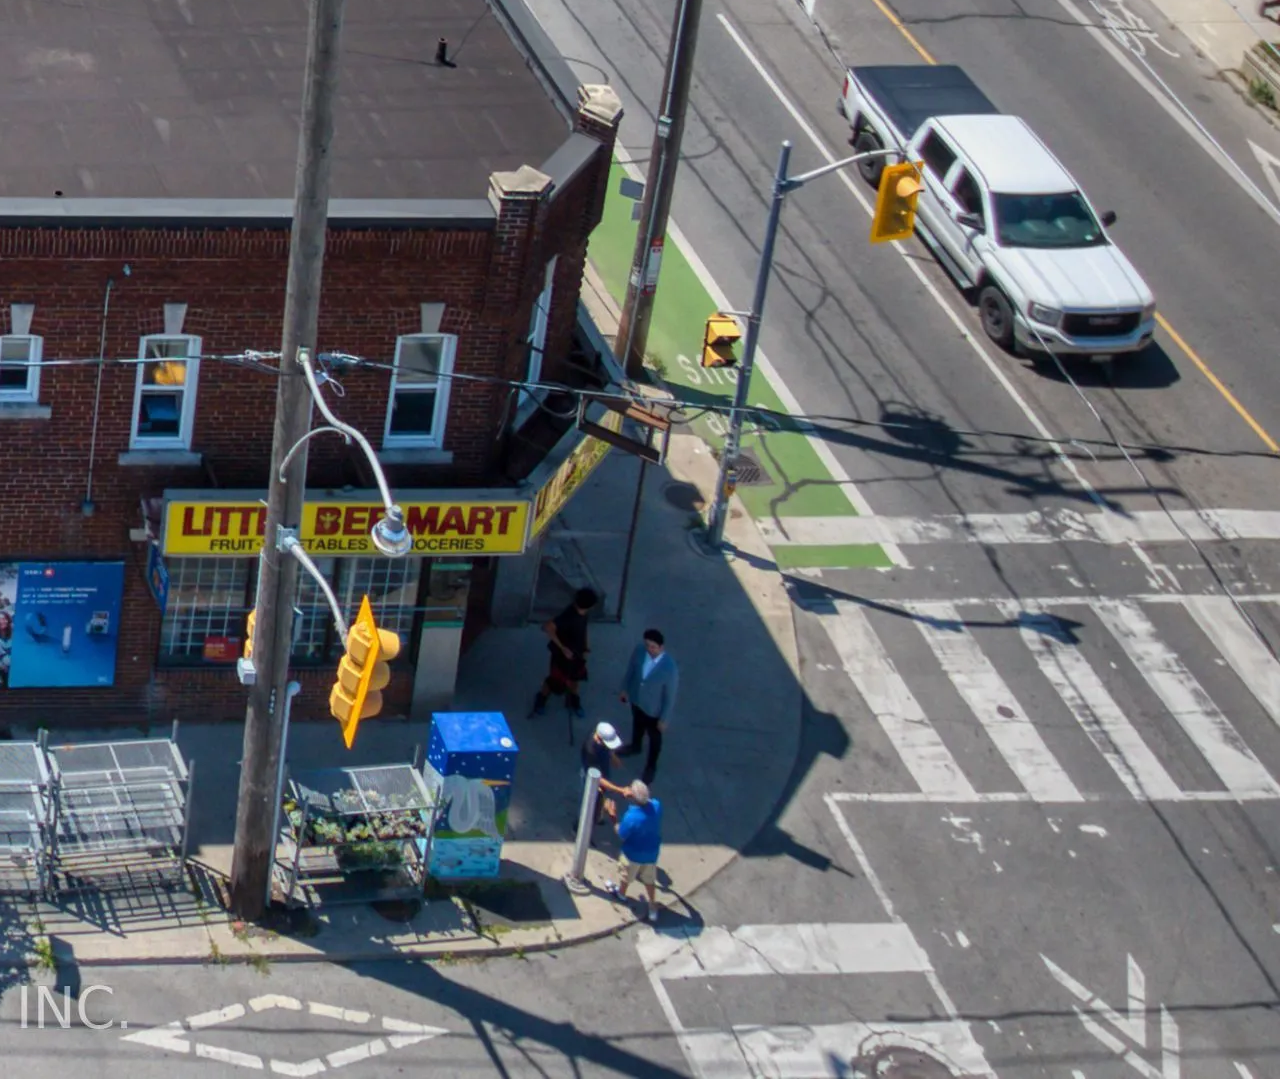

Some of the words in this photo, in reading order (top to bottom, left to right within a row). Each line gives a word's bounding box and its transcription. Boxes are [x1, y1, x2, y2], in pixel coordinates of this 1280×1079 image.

[182, 506, 269, 536] LITTL
[407, 505, 518, 535] MART
[411, 537, 485, 551] OCERIES
